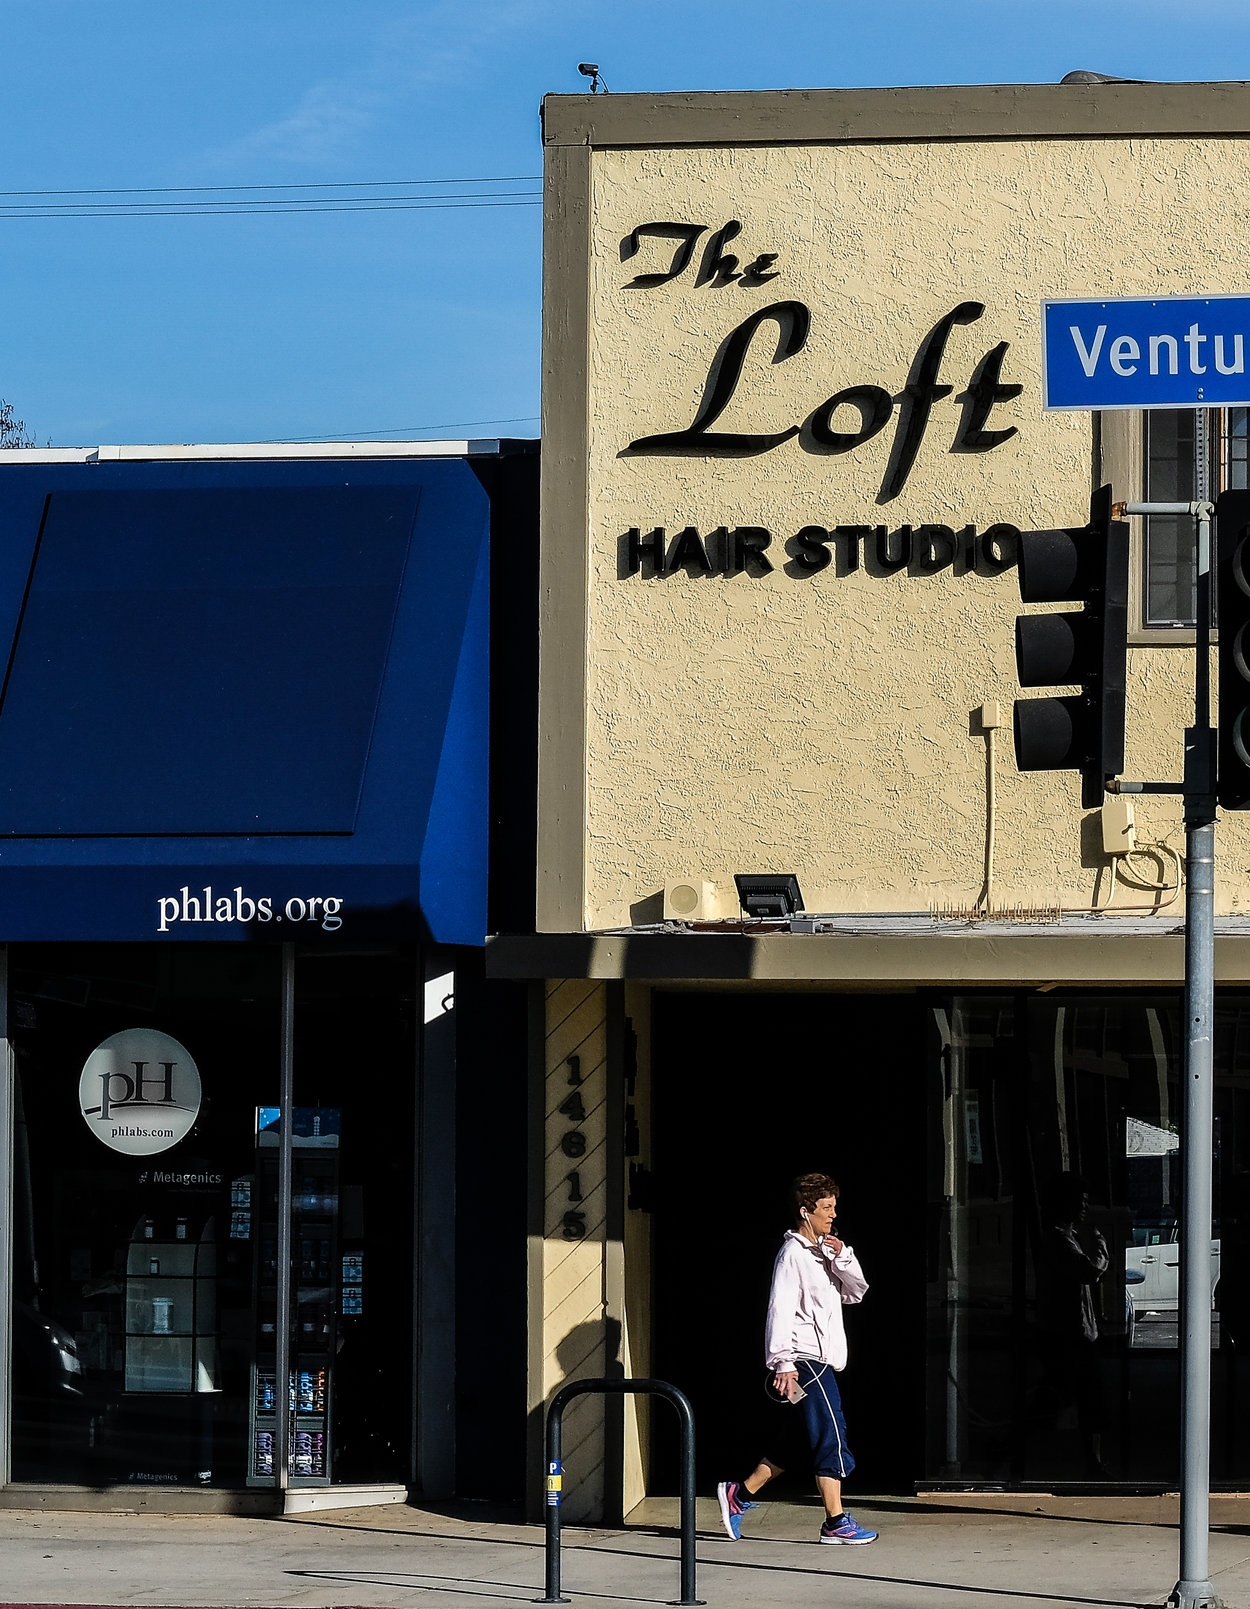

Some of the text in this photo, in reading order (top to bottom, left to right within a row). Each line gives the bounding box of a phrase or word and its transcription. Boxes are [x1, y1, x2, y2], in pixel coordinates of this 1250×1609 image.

[620, 219, 780, 289] The
[616, 300, 1023, 505] Loft
[622, 523, 1021, 578] HAIR STUDIO
[157, 885, 344, 932] phlabs.org
[97, 1061, 178, 1120] pH
[111, 1125, 174, 1139] phlabs.com
[558, 1055, 587, 1241] 14615
[153, 1171, 222, 1186] Metagenics
[549, 1462, 557, 1474] P
